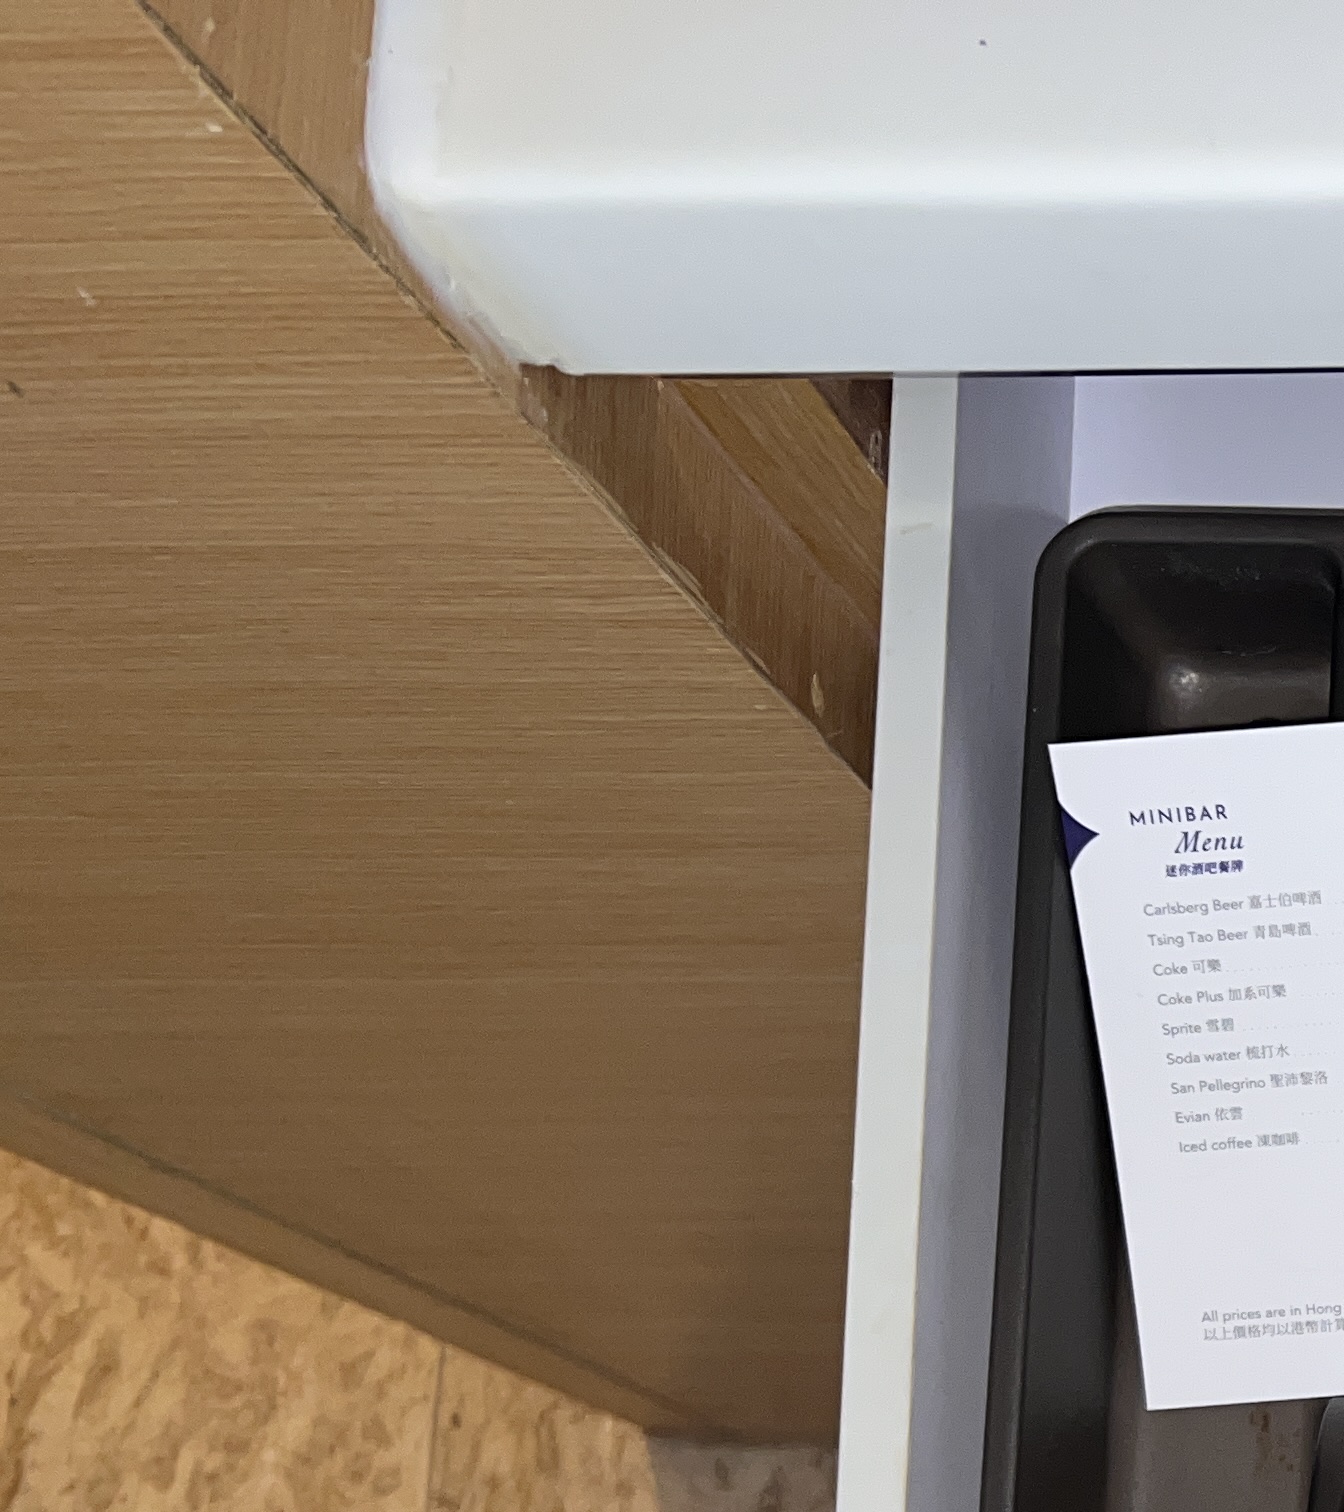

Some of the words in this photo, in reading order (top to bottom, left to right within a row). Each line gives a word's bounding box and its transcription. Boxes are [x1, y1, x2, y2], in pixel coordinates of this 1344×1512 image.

[1129, 804, 1228, 826] MINIBAR
[1174, 830, 1245, 854] Menu
[1165, 859, 1244, 878] 迷你酒吧餐牌
[1143, 900, 1209, 916] Carlsberg
[1212, 898, 1244, 912] Beer
[1247, 890, 1322, 909] 嘉士伯啤酒
[1147, 933, 1184, 948] Tsing
[1186, 931, 1214, 943] Tao
[1217, 929, 1248, 942] Beer
[1153, 962, 1188, 976] Coke
[1191, 958, 1222, 974] 可樂
[1157, 992, 1193, 1006] Coke
[1196, 990, 1224, 1003] Plus
[1162, 1023, 1202, 1038] Sprite
[1166, 1052, 1201, 1065] Soda
[1204, 1050, 1241, 1062] water
[1246, 1044, 1290, 1060] 梳打水
[1171, 1082, 1195, 1095] San
[1199, 1078, 1266, 1093] Pellegrino
[1175, 1110, 1211, 1123] Evian
[1179, 1139, 1207, 1153] Iced
[1211, 1136, 1253, 1151] coffee
[1201, 1310, 1218, 1323] All
[1222, 1308, 1261, 1324] prices
[1265, 1309, 1286, 1319] are
[1290, 1305, 1302, 1316] in
[1306, 1303, 1342, 1317] Hong
